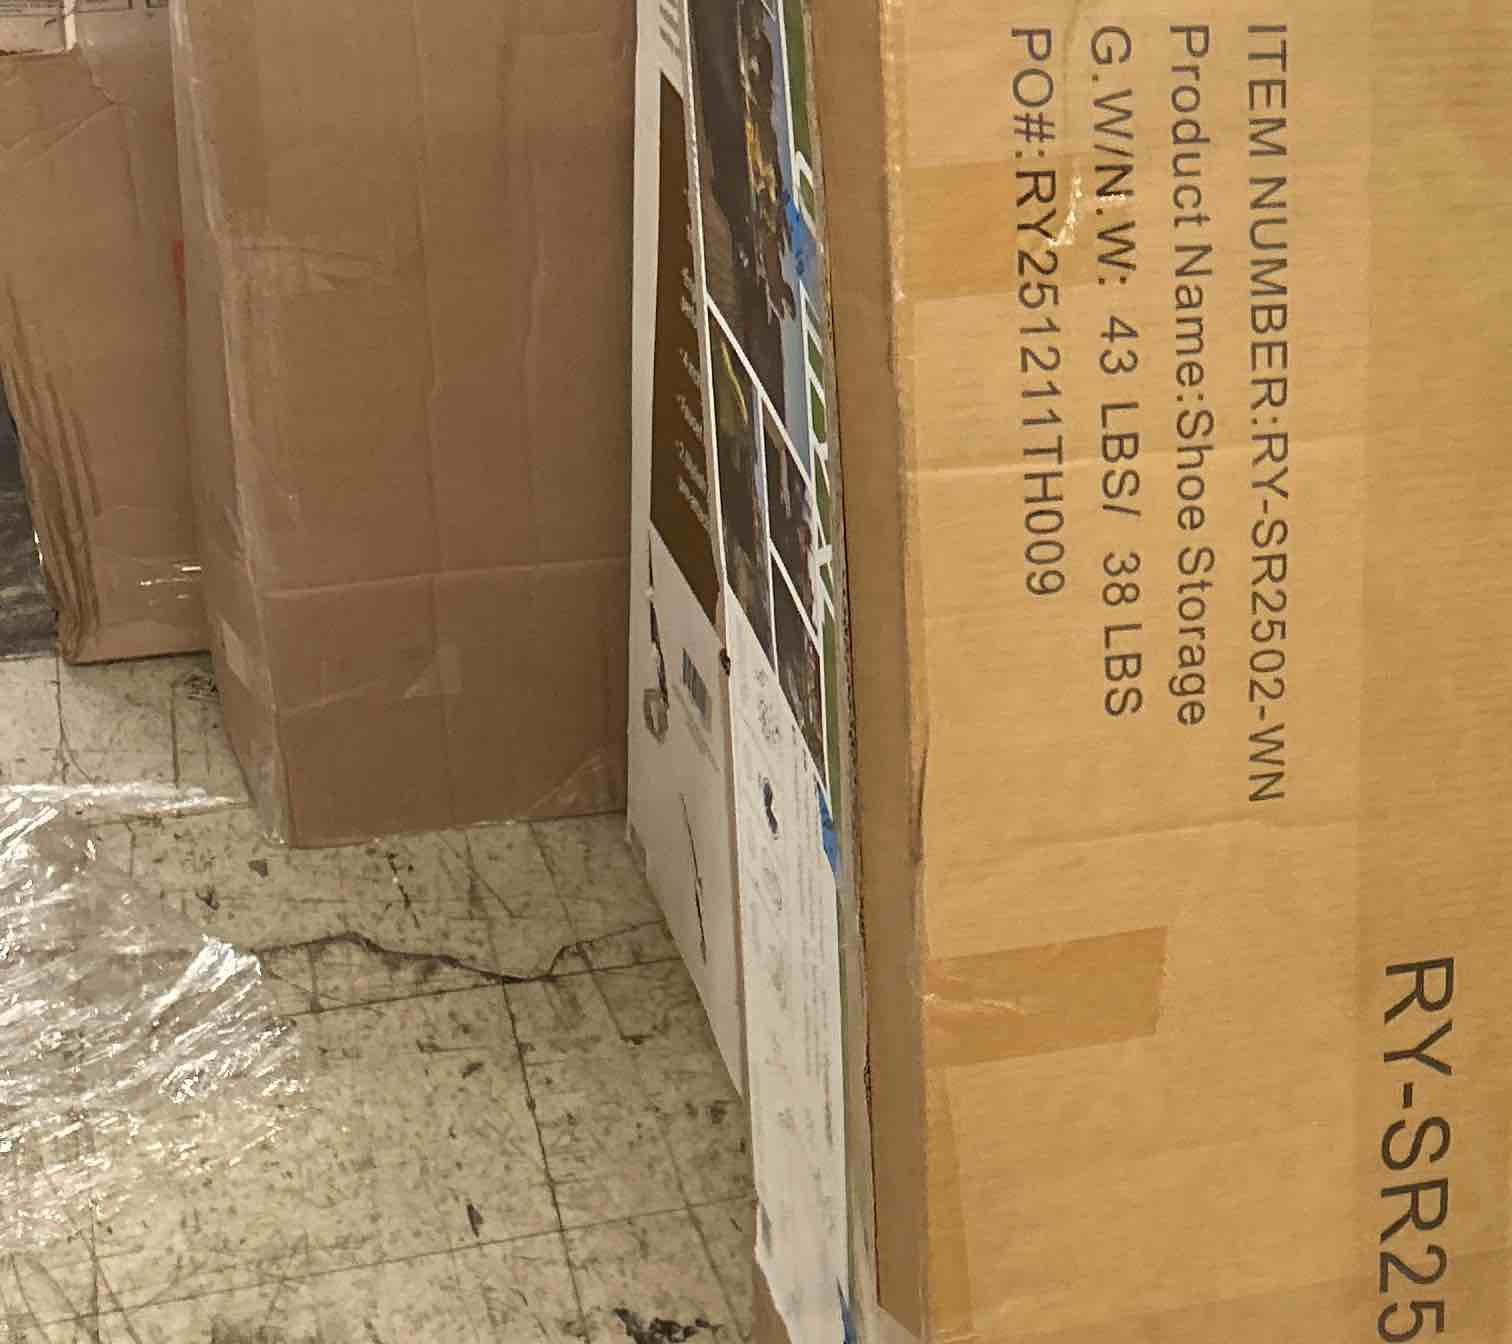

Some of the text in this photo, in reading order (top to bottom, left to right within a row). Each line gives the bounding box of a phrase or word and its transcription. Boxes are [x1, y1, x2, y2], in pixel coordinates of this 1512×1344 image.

[1090, 25, 1144, 718] G.W/N.W: 43 LBS/ 38 LBS
[1168, 24, 1216, 727] Product Name:Shoe Storage
[1247, 25, 1288, 157] ITEM
